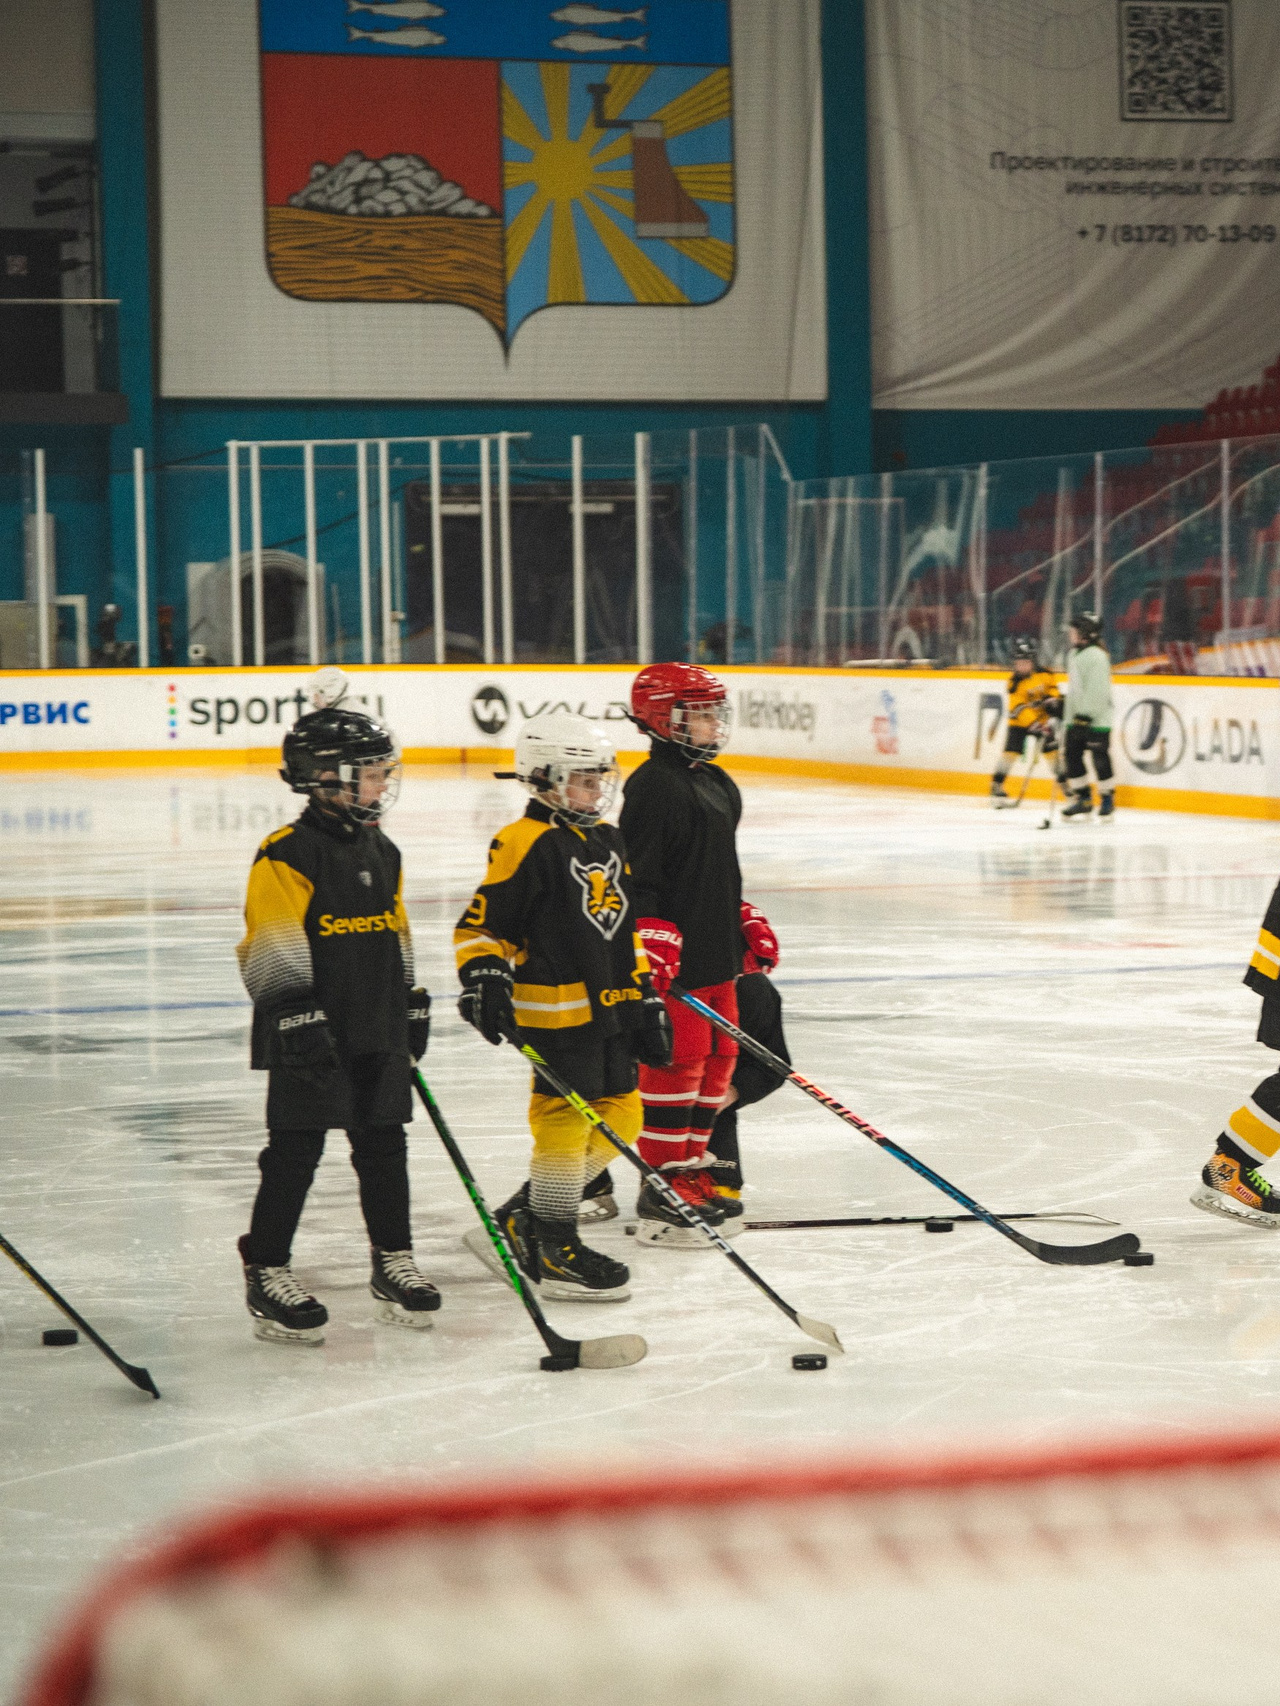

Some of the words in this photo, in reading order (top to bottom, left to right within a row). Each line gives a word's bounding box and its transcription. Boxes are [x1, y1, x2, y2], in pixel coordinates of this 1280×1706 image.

[989, 151, 1177, 175] Проектирование
[1181, 157, 1195, 172] и
[1064, 181, 1203, 199] инженерных
[1113, 223, 1178, 247] (8172)
[1184, 223, 1277, 243] 70-13-09
[1193, 717, 1265, 766] LADA
